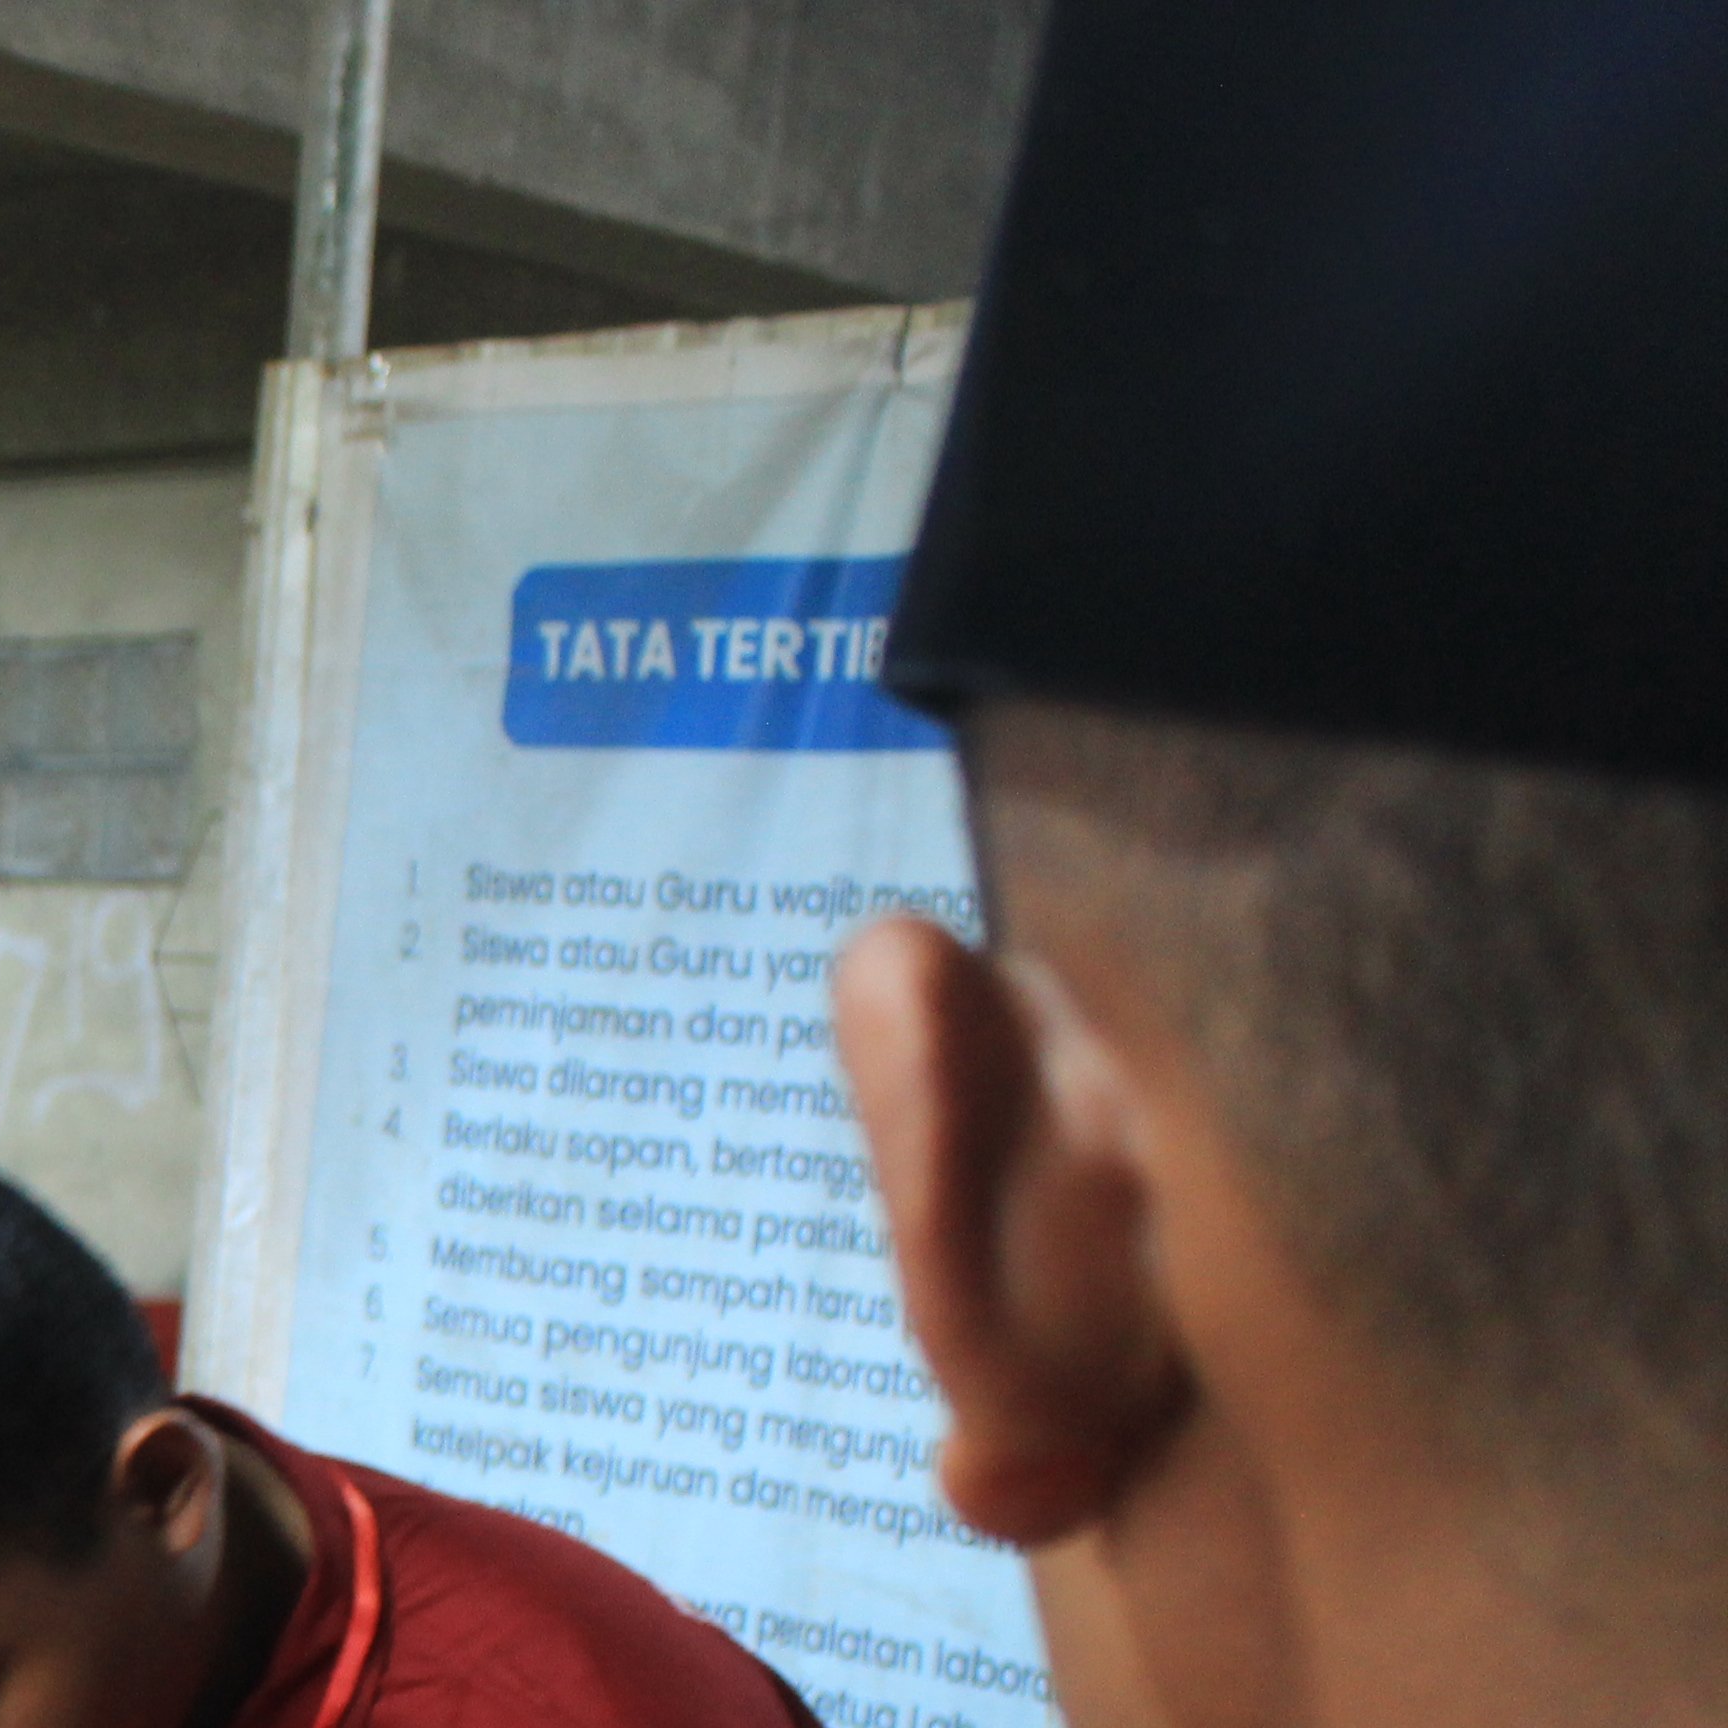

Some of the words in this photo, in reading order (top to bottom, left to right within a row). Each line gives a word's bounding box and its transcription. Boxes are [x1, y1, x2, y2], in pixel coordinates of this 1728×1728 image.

[539, 620, 676, 682] TATA
[463, 861, 556, 905] Siswa
[562, 869, 644, 911] atau
[655, 870, 757, 915] Guru
[771, 874, 863, 932] wajib
[459, 924, 545, 968] Siswa
[558, 931, 640, 974] atau
[650, 935, 755, 981] Guru
[453, 991, 673, 1046] peminjaman
[684, 1003, 767, 1047] dan
[447, 1049, 537, 1094] Siswa
[547, 1059, 706, 1120] dilarang
[442, 1110, 556, 1161] Berlaku
[564, 1128, 699, 1178] sopan,
[437, 1175, 585, 1228] diberikan
[596, 1194, 742, 1242] selama
[430, 1236, 628, 1308] Membuang
[637, 1262, 795, 1317] sampah
[805, 1280, 896, 1330] harus
[421, 1297, 532, 1346] Semua
[544, 1317, 774, 1390] pengunjung
[415, 1357, 528, 1409] Semua
[541, 1376, 645, 1424] siswa
[657, 1399, 746, 1451] yang
[561, 1445, 717, 1498] kejuruan
[729, 1467, 800, 1510] dan
[757, 1608, 923, 1676] peralatan
